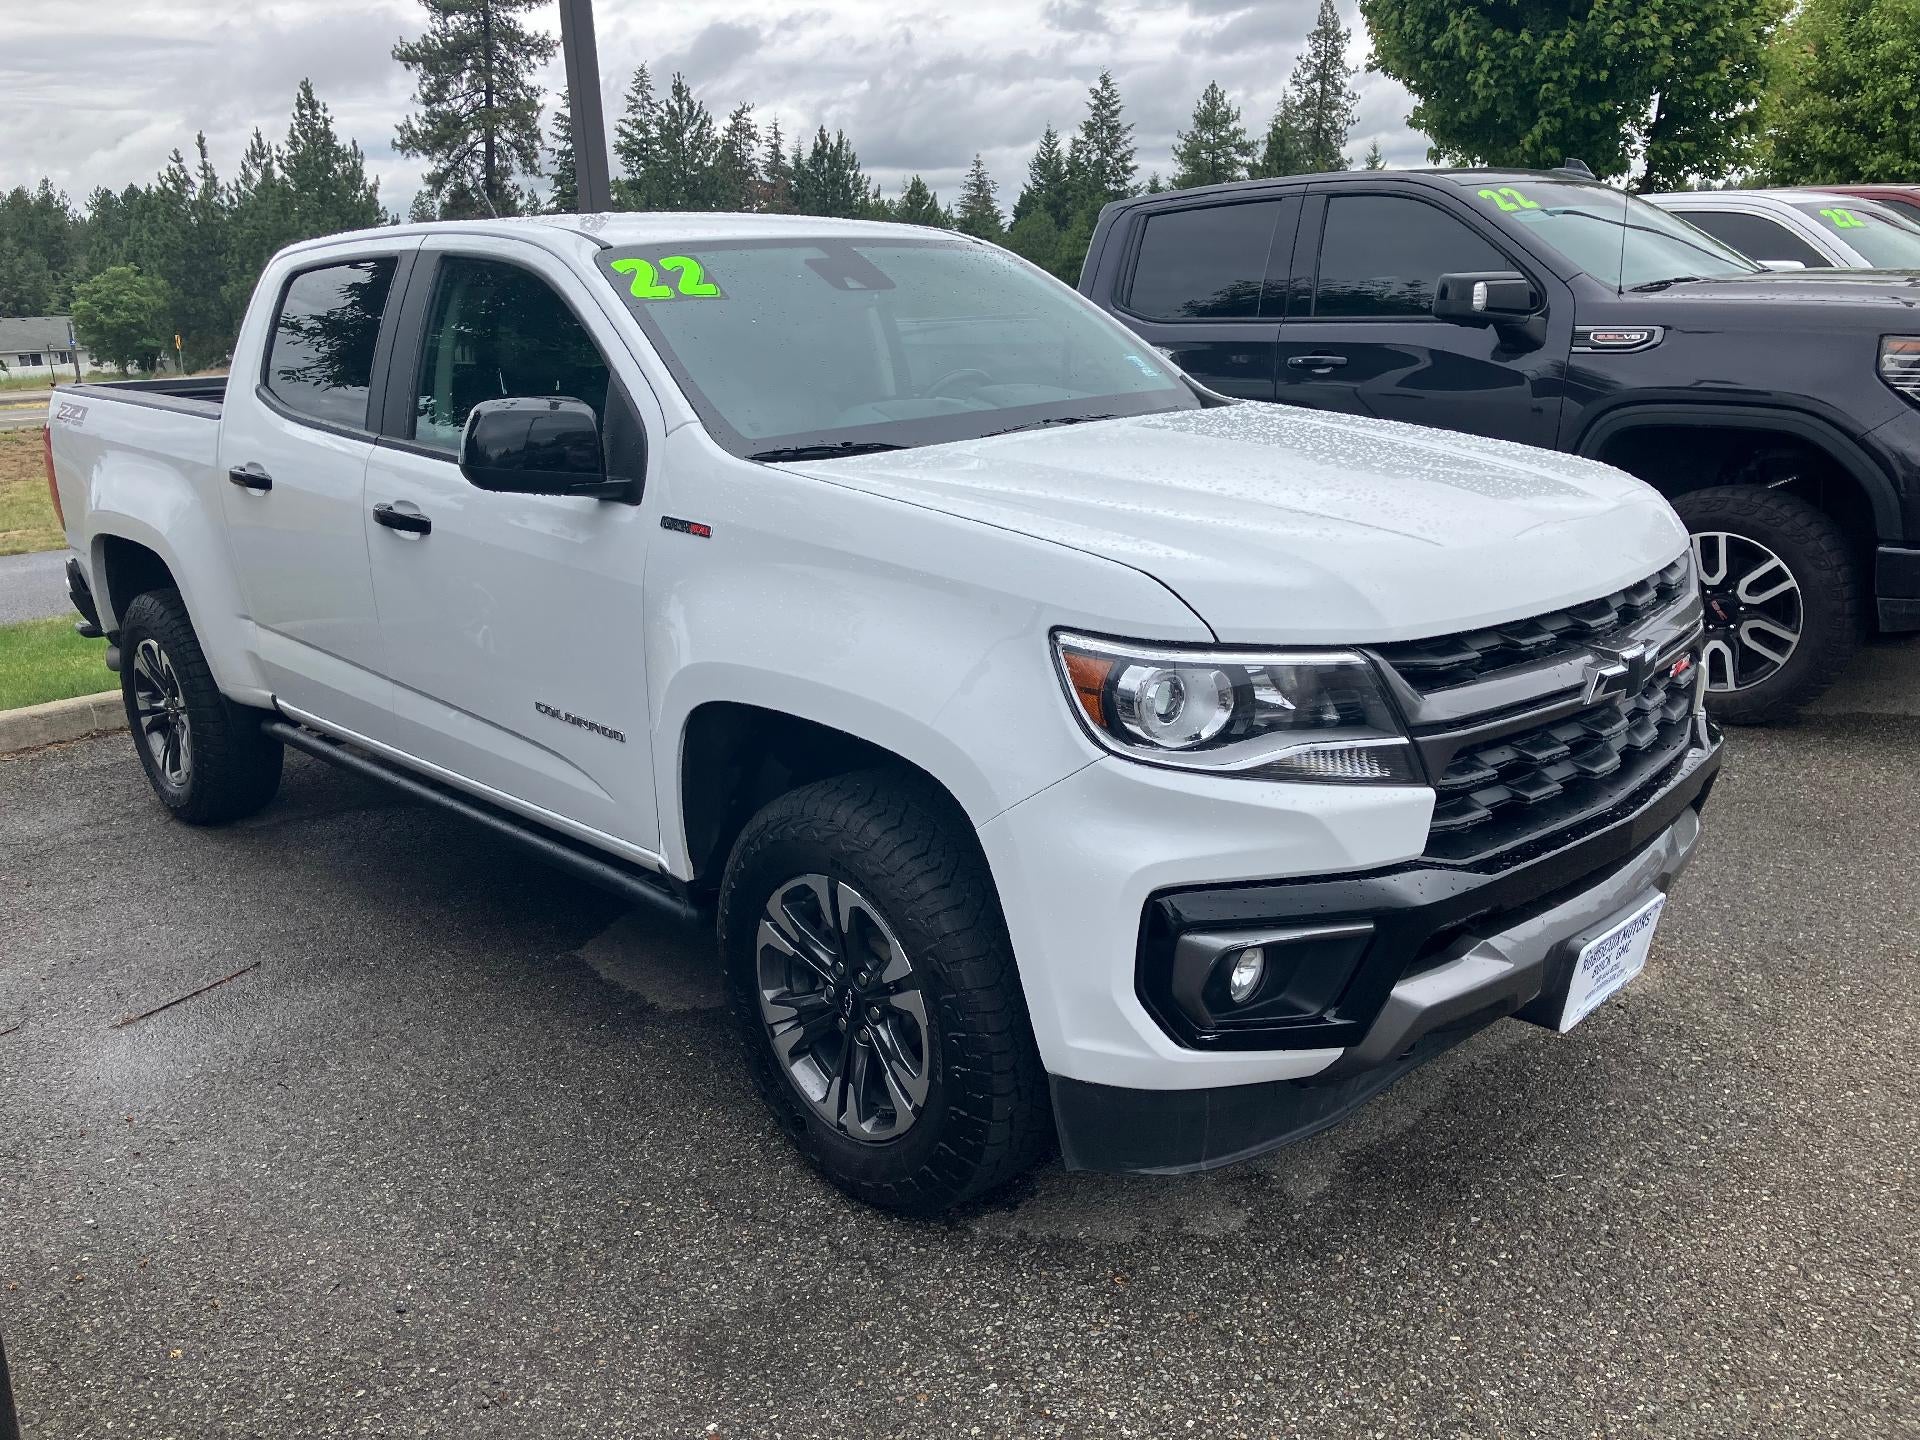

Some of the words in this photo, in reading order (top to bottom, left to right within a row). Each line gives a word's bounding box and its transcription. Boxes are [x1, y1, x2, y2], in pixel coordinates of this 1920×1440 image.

[1477, 187, 1540, 212] 22
[1819, 208, 1866, 228] 22
[611, 256, 720, 299] 22
[535, 702, 626, 743] COLORADO
[1620, 911, 1652, 943] MOTORS
[1615, 939, 1632, 960] GMC
